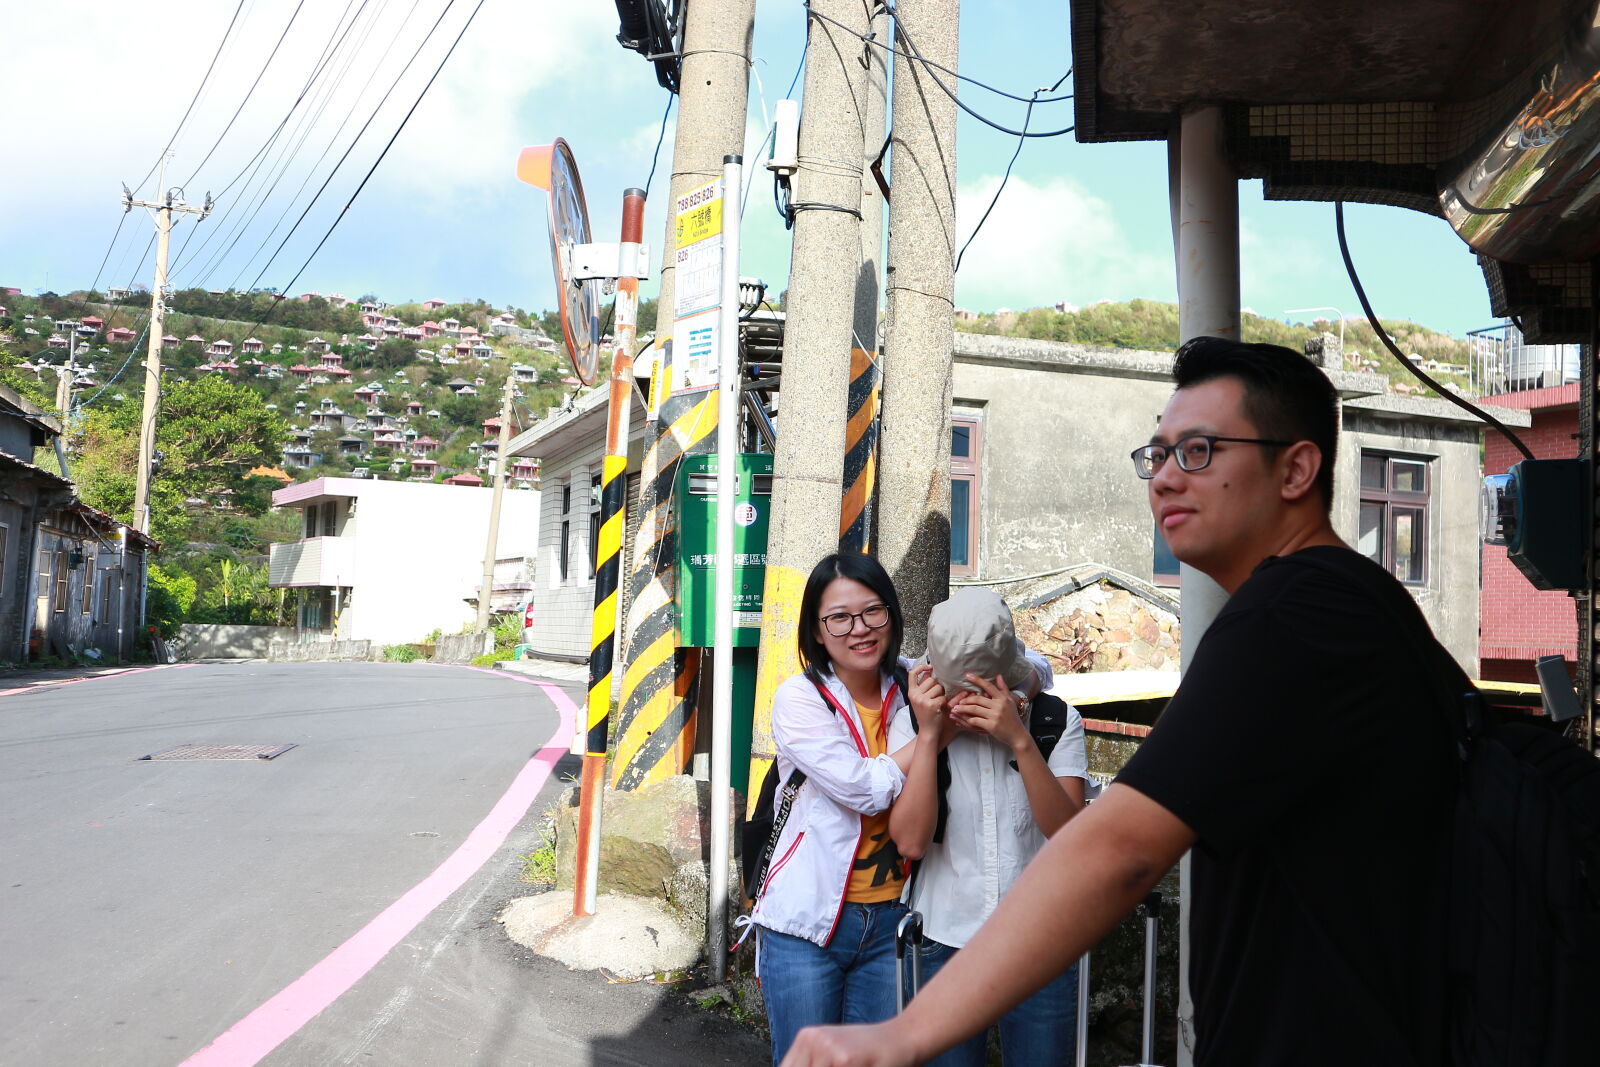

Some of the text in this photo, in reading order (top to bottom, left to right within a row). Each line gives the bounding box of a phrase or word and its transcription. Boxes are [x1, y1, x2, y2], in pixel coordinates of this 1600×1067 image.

[689, 192, 701, 207] 825
[702, 186, 714, 201] 826
[677, 249, 689, 263] 826
